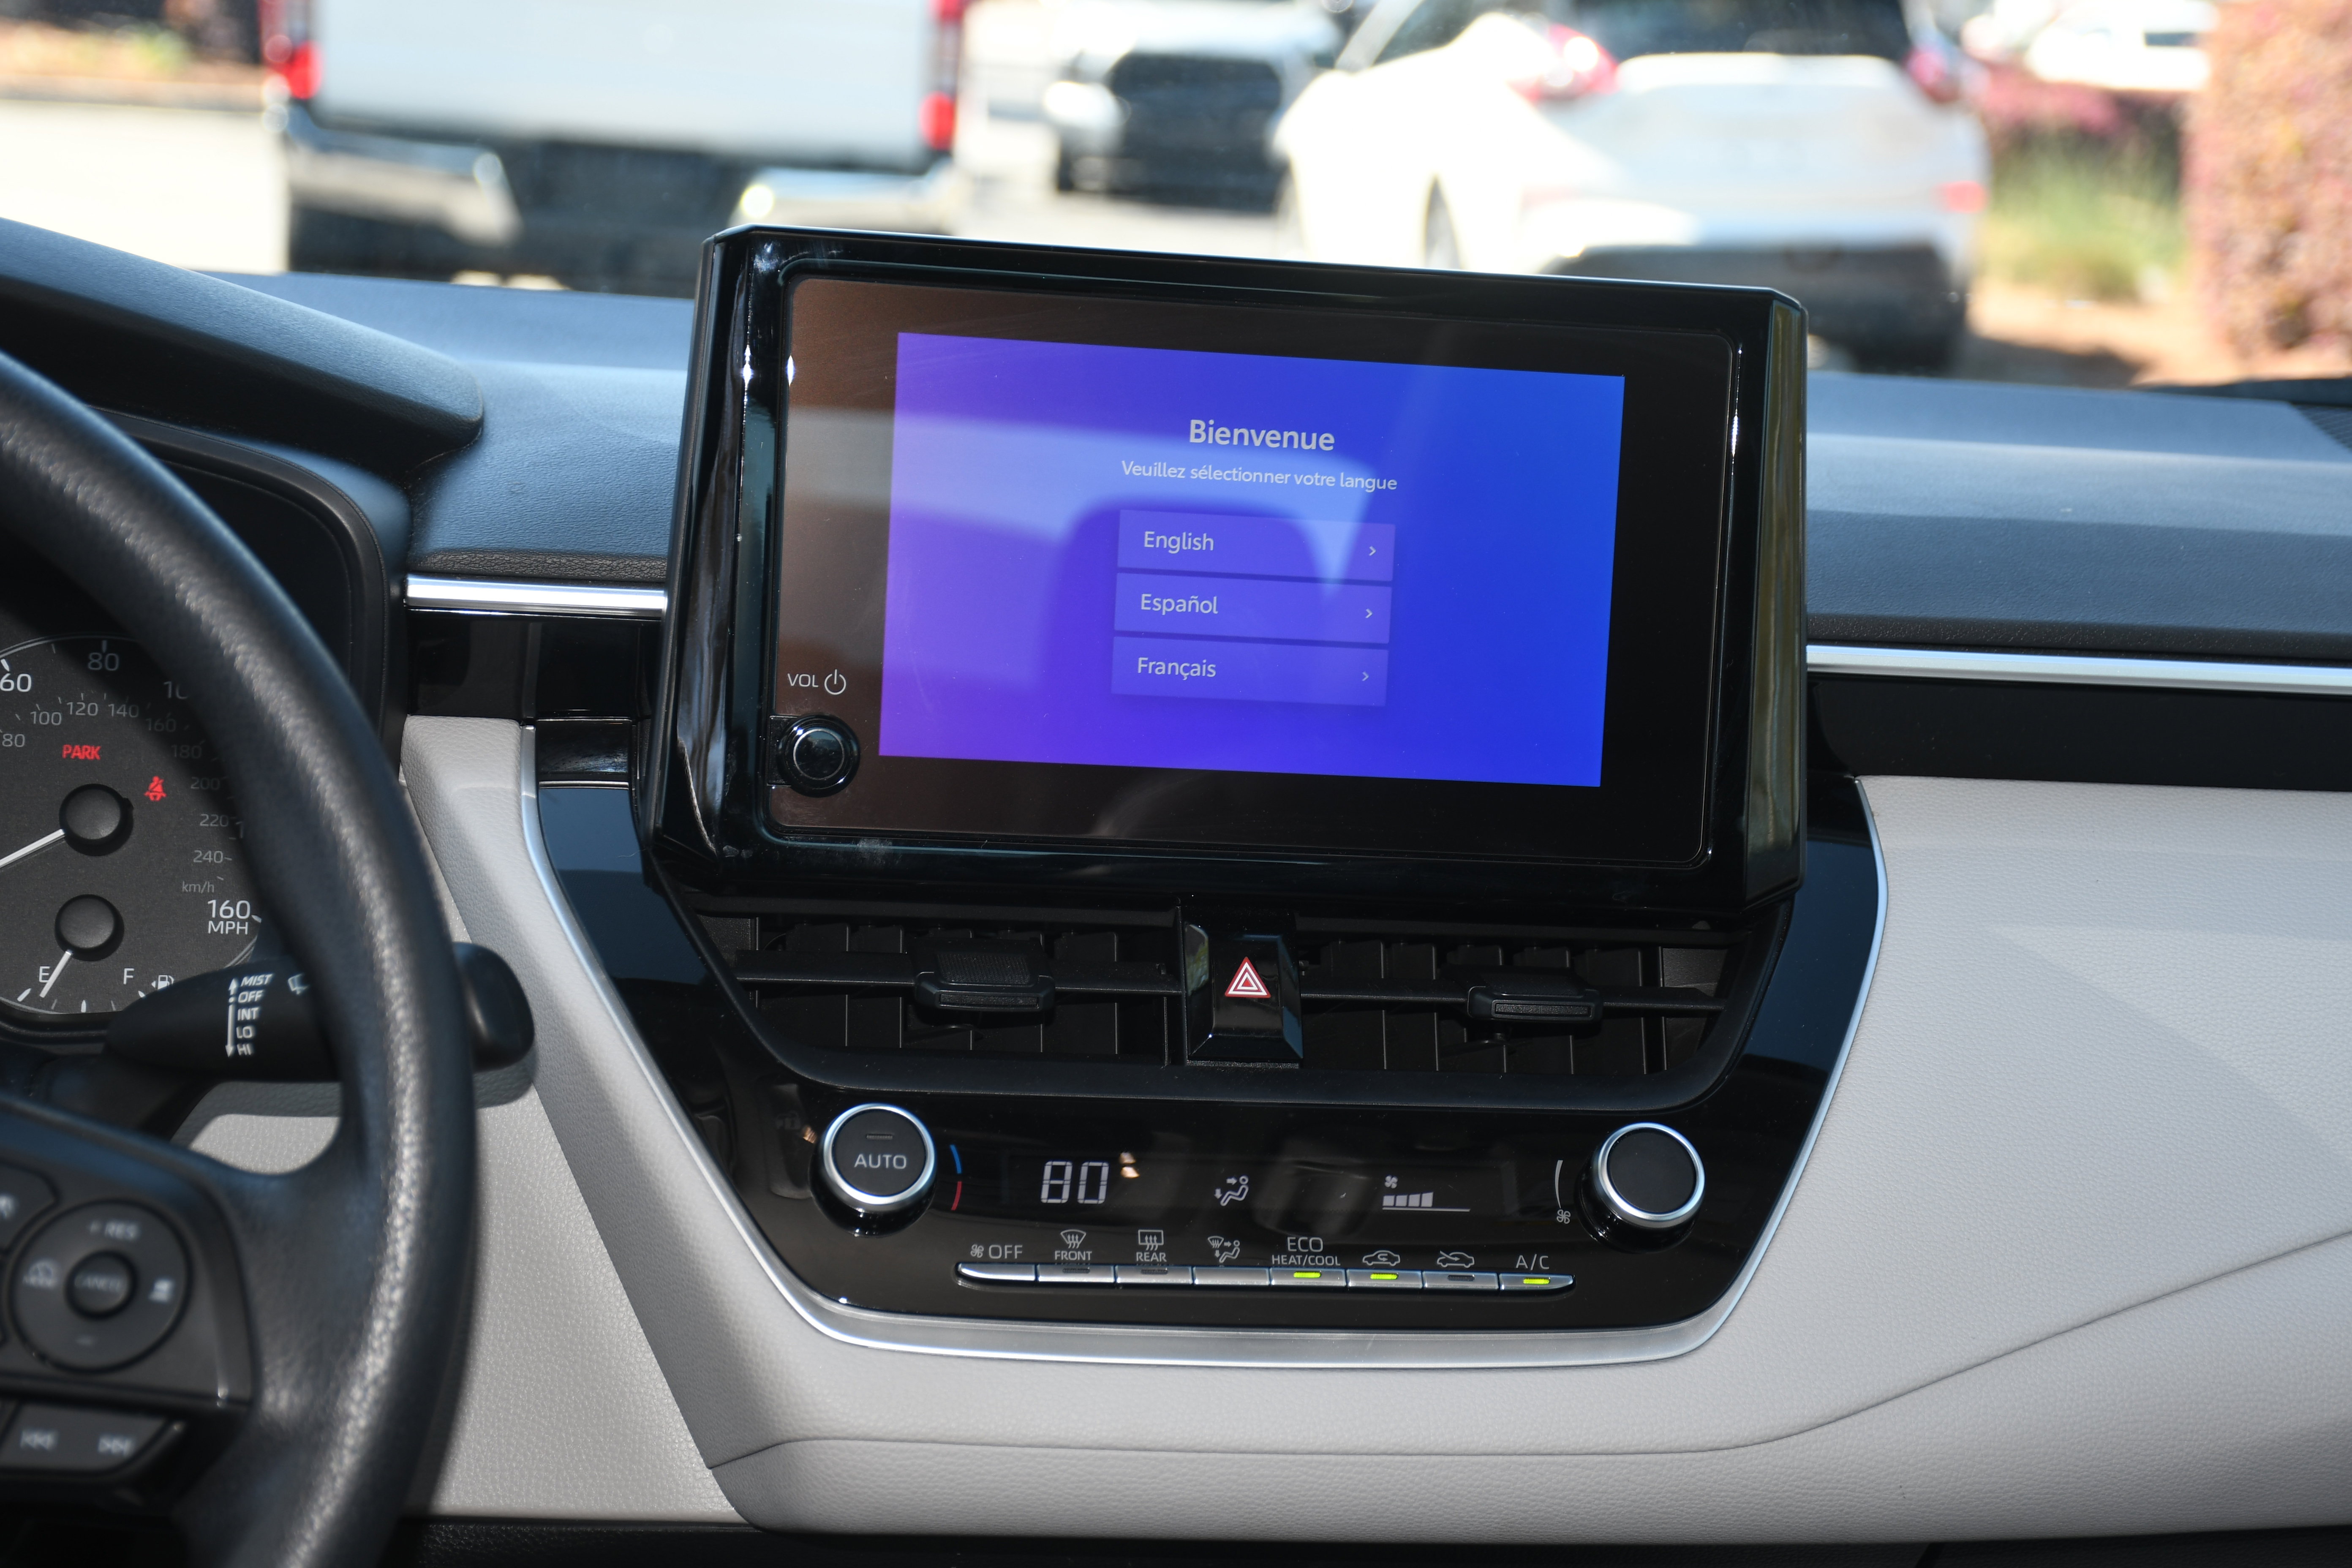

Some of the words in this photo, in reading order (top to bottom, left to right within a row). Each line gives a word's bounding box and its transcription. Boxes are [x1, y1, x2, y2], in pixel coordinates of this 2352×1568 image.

[1189, 419, 1335, 451] Bienvenue
[1122, 460, 1186, 478] Veuillez
[1190, 464, 1291, 485] sélectionner
[1293, 473, 1336, 487] votre
[1340, 472, 1397, 493] langue
[1143, 531, 1214, 554] English
[1140, 593, 1218, 615] Español
[87, 652, 120, 671] 80
[1137, 656, 1217, 680] Français
[0, 673, 32, 692] 60
[787, 673, 819, 687] VOL
[66, 701, 99, 716] 120
[108, 703, 139, 718] 140
[30, 711, 62, 726] 100
[146, 718, 177, 732] 160
[2, 733, 25, 748] 80
[62, 744, 101, 760] PARK
[171, 744, 202, 759] 180
[191, 776, 220, 790] 200
[199, 813, 229, 827] 220
[193, 850, 224, 864] 240
[182, 881, 215, 895] km/h
[207, 899, 251, 920] 160
[208, 920, 249, 935] MPH
[38, 966, 51, 983] E
[123, 968, 135, 985] F
[240, 973, 274, 987] MIST
[237, 989, 264, 1003] OFF
[237, 1007, 260, 1021] INT
[236, 1025, 253, 1039] LO
[236, 1043, 253, 1056] HI
[854, 1154, 907, 1170] AUTO
[1040, 1160, 1109, 1204] 80
[988, 1244, 1024, 1260] OFF
[1287, 1236, 1324, 1253] ECO
[1054, 1250, 1092, 1261] FRONT
[1136, 1251, 1167, 1263] REAR
[1271, 1254, 1341, 1266] HEAT/COOL
[1515, 1255, 1550, 1270] A/C
